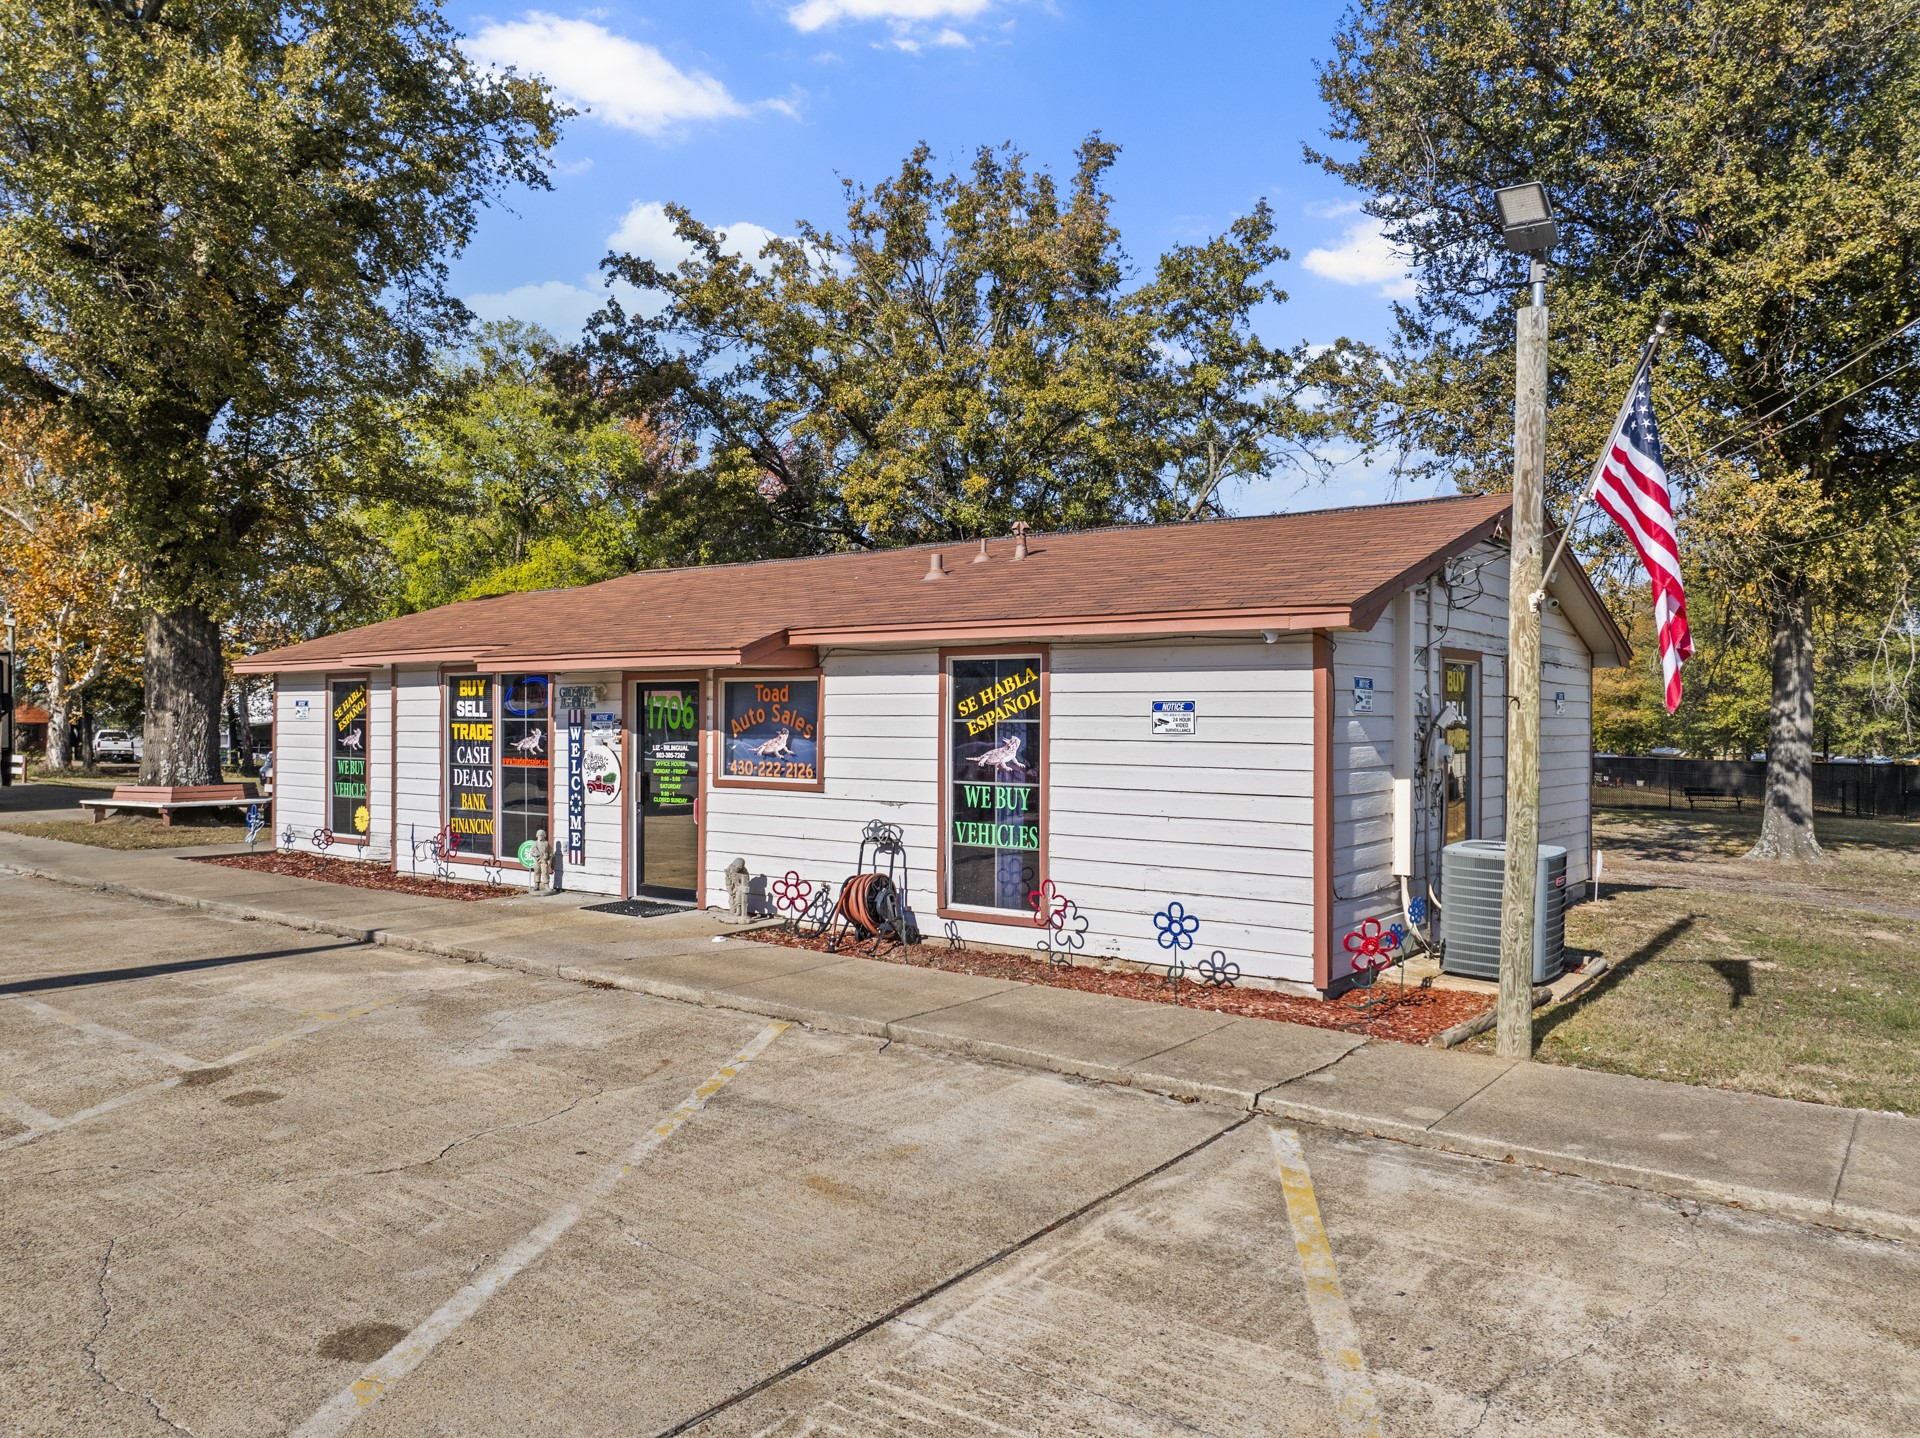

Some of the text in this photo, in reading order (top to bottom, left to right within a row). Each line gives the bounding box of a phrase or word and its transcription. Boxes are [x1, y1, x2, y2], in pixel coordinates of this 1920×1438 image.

[459, 680, 486, 696] BUY
[1447, 671, 1465, 692] BUY
[333, 684, 365, 720] SE HABLA
[755, 684, 789, 703] Toad
[957, 667, 1039, 717] SE HABLA
[338, 697, 367, 731] ESPAÑOL
[456, 701, 487, 717] SELL
[648, 695, 694, 729] 1706
[966, 689, 1041, 737] ESPAÑOL
[1162, 703, 1185, 711] NOTICE
[731, 703, 814, 739] Auto Sales
[451, 723, 493, 741] TRADE
[456, 746, 490, 764] CASH
[337, 760, 364, 775] WE BUY
[729, 759, 814, 779] 430-222-2126
[453, 769, 493, 788] DEALS
[570, 726, 582, 847] WELCOME
[461, 793, 487, 811] BANK
[965, 785, 1031, 811] WE BUY
[955, 821, 1039, 849] VEHICLES
